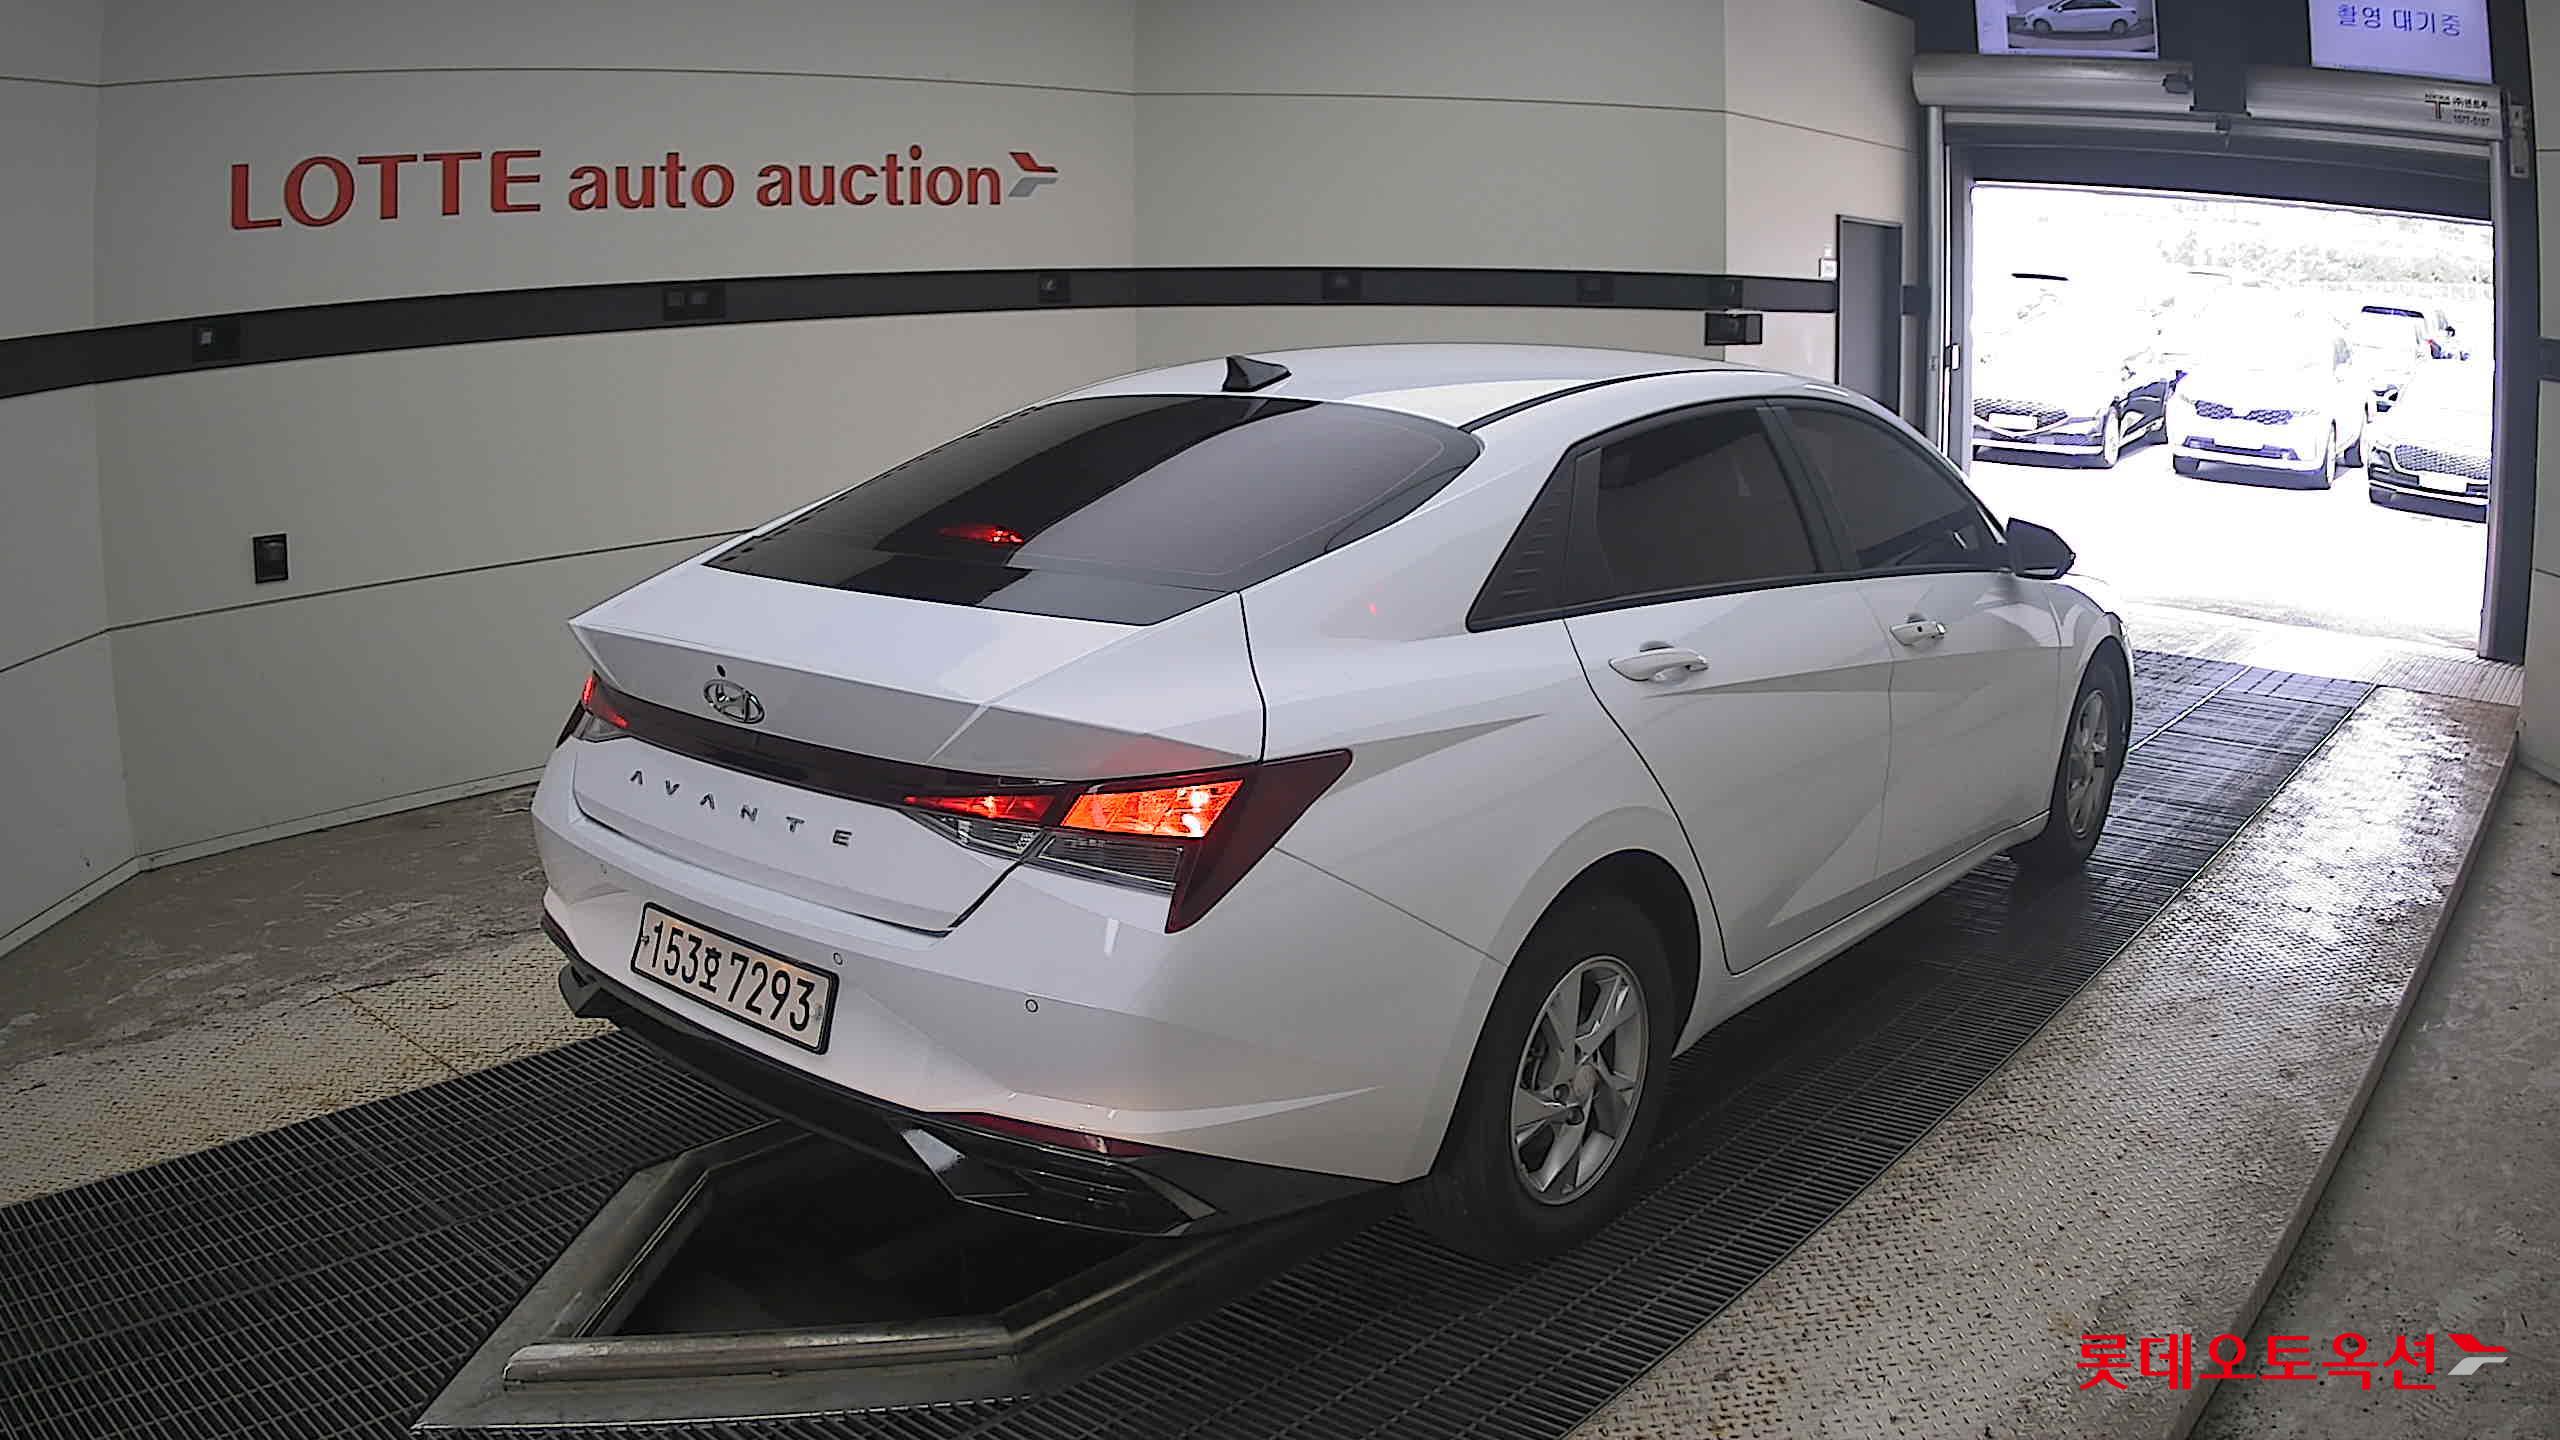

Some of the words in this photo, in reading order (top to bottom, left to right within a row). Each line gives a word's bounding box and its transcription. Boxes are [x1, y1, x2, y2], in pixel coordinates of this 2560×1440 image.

[2338, 4, 2381, 29] 촬영
[2393, 7, 2461, 37] 대기중
[231, 149, 541, 231] LOTTE
[568, 151, 735, 210] auto
[756, 144, 1001, 207] auction
[630, 770, 852, 846] AVANTE
